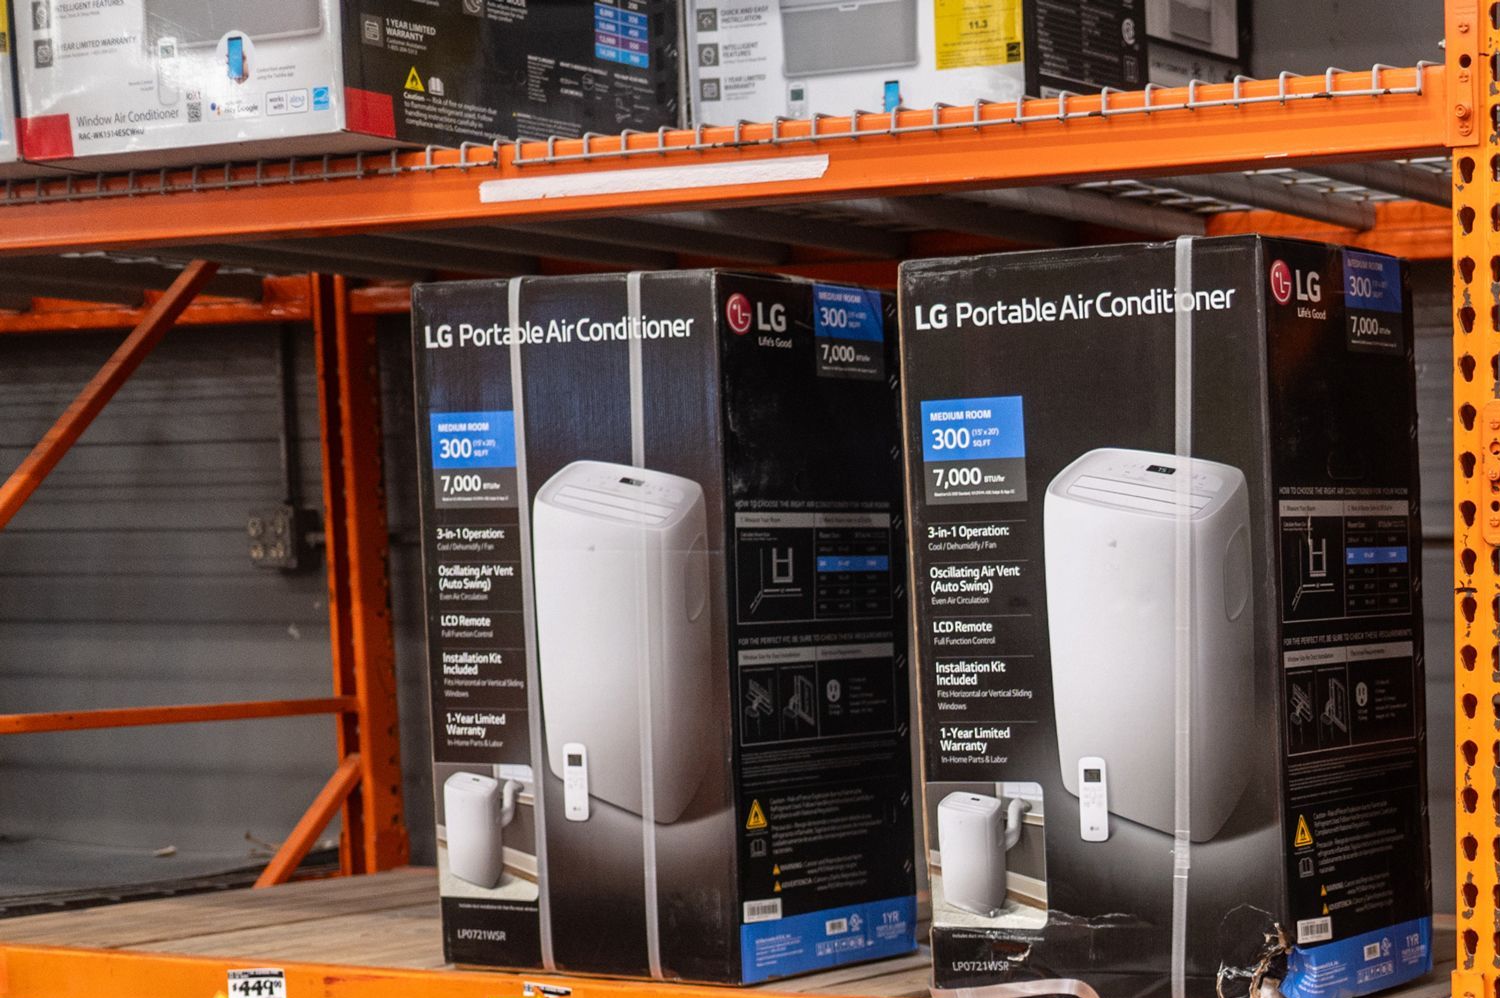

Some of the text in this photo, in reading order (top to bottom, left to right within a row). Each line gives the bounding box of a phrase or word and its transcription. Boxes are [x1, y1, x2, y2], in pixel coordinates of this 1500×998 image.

[391, 19, 411, 30] YEAR
[414, 23, 436, 36] LIMITED
[386, 28, 424, 42] WARRANTY
[77, 108, 179, 128] Window Air Conditioner
[1296, 271, 1320, 302] LG
[757, 303, 787, 332] LG
[915, 304, 948, 330] LG
[956, 299, 1056, 328] Portable
[1059, 294, 1090, 320] Air
[425, 325, 452, 349] LG
[546, 320, 574, 343] Air
[576, 317, 693, 342] Conditioner
[930, 409, 991, 421] MEDIUM ROOM
[932, 429, 970, 450] 300
[932, 468, 981, 487] 7,000
[928, 526, 1009, 539] 3-in-1 Operation:
[930, 566, 1020, 580] Oscillating Air Vent
[931, 580, 993, 594] (Auto Swing)
[933, 622, 992, 632] LCD Remote
[936, 662, 1006, 673] Installation Kit
[937, 675, 977, 685] Included
[940, 727, 1010, 739] 1-Year Limited
[940, 740, 987, 753] Warranty
[458, 929, 506, 941] LP0721WSR
[953, 961, 1009, 972] LP0721WSR
